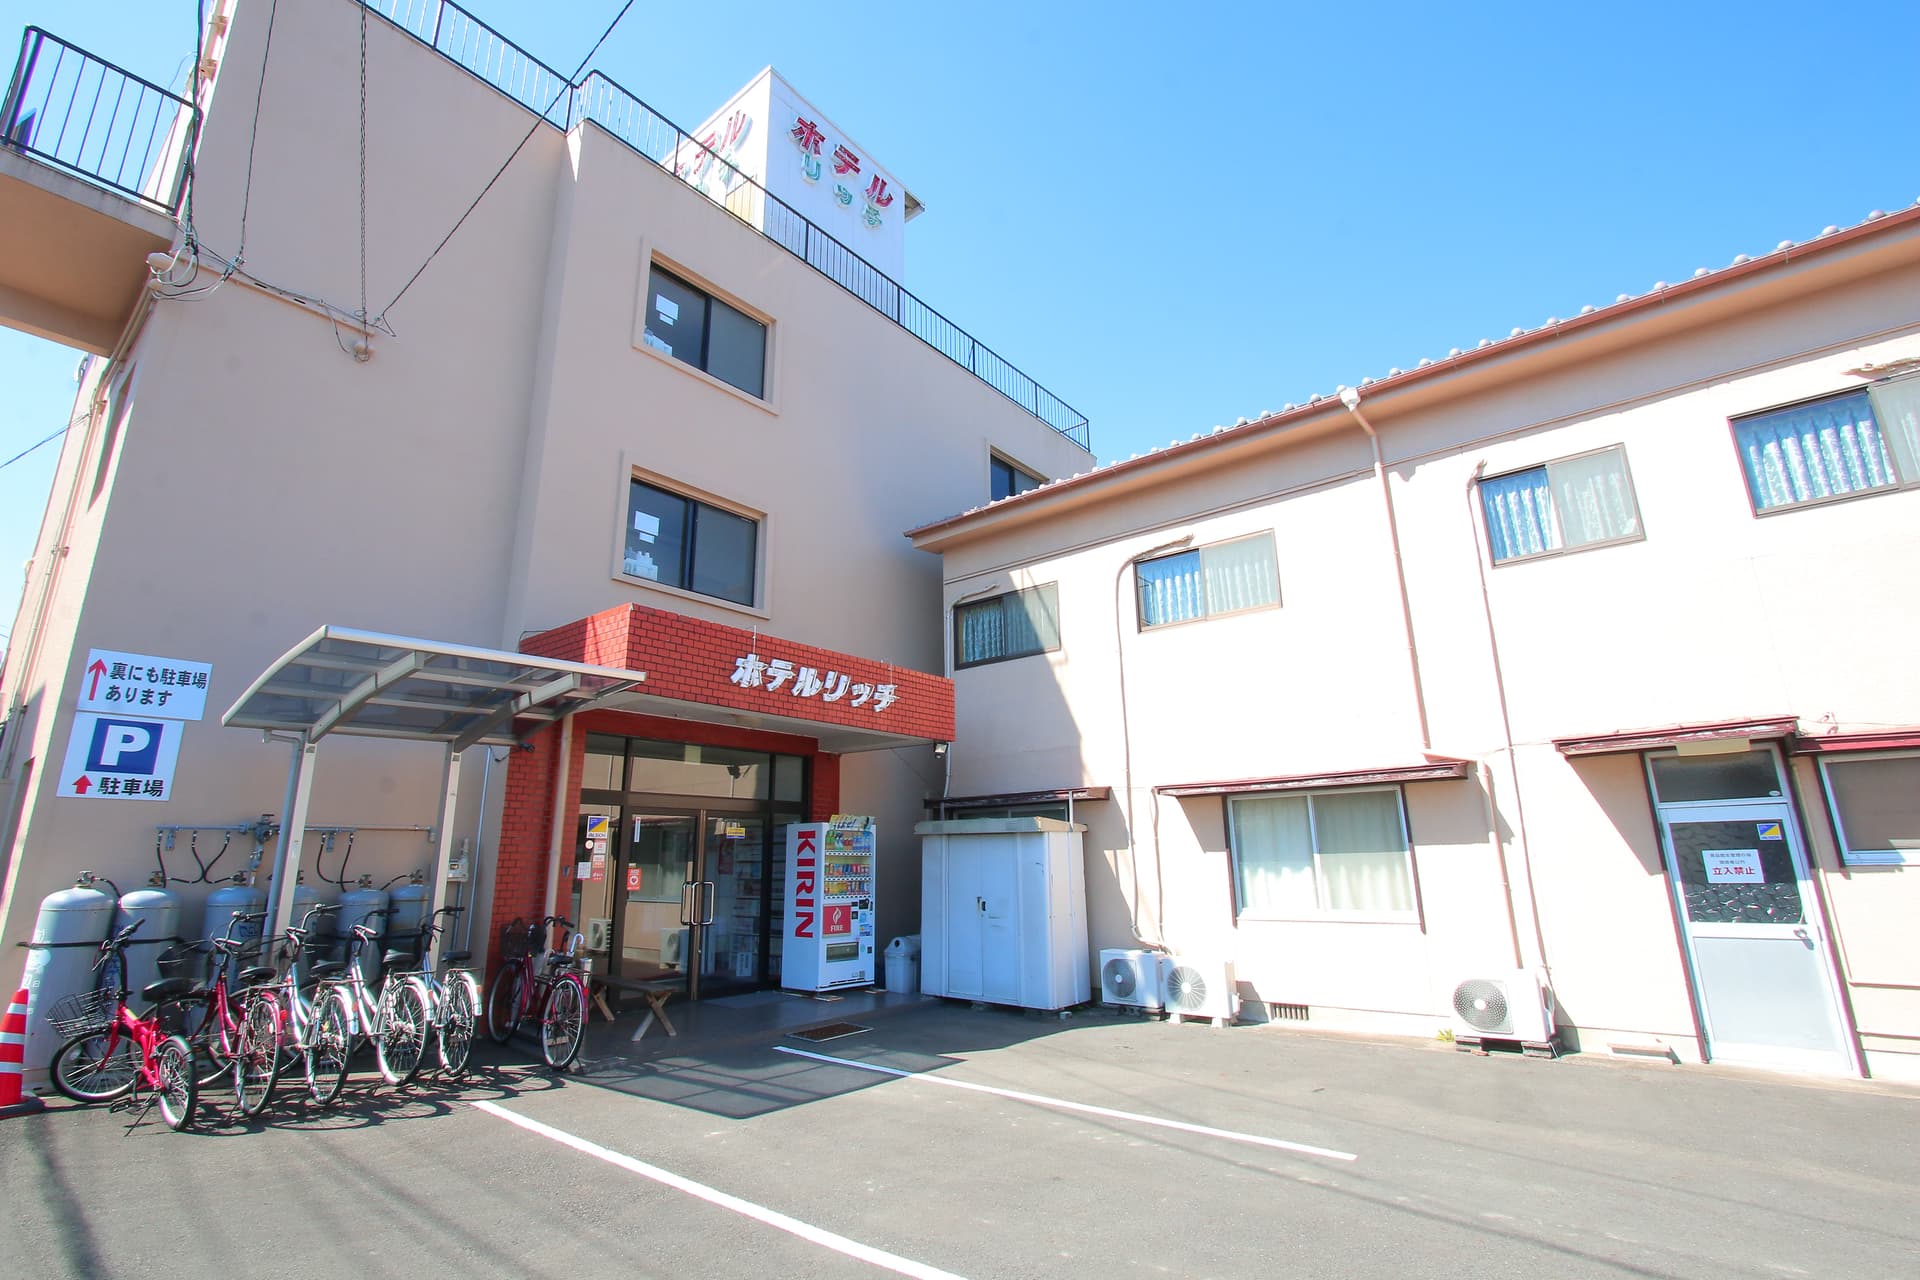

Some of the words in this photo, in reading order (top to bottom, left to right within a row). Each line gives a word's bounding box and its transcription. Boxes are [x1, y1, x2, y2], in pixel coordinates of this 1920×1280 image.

[790, 115, 894, 208] ホテル
[109, 662, 209, 689] 裏にも駐車場
[730, 653, 900, 713] ホテルリッチ
[105, 684, 173, 706] あります
[100, 724, 151, 766] P
[98, 776, 165, 797] 駐車場
[795, 830, 816, 939] KIRIN
[1712, 866, 1755, 876] 立入禁止
[830, 924, 844, 933] FIRE
